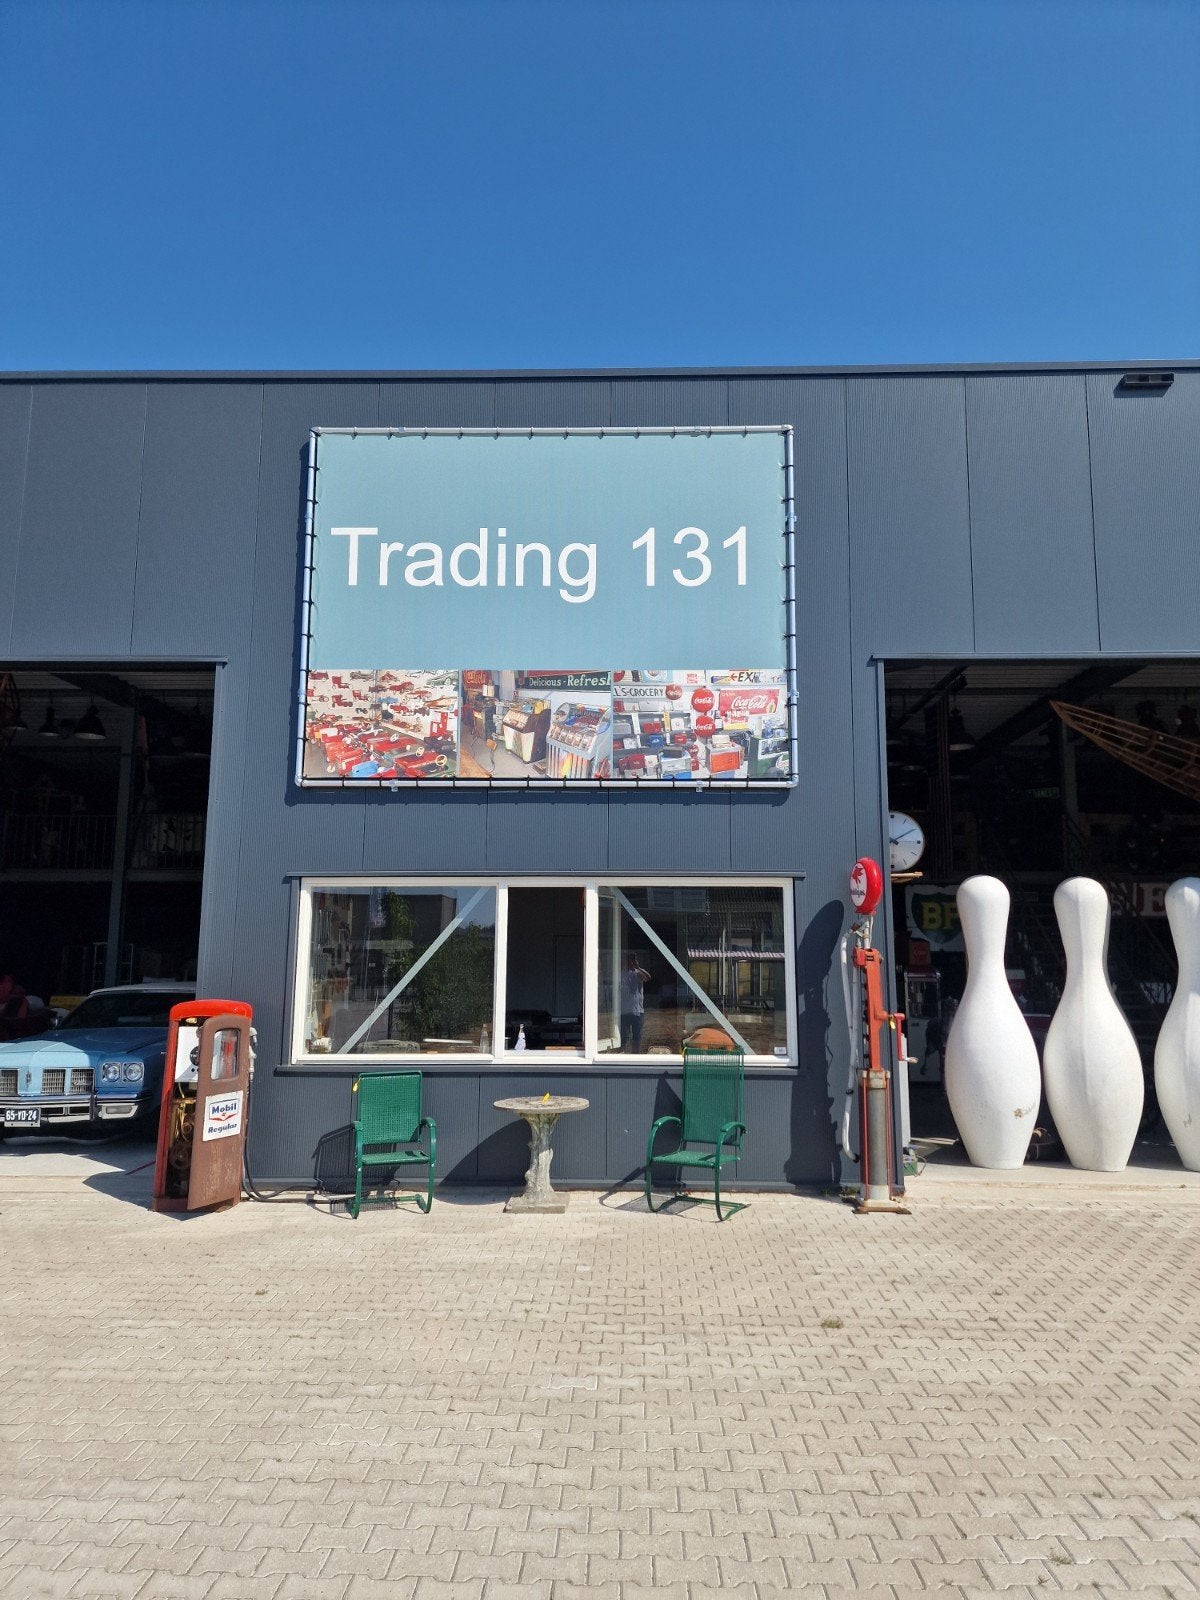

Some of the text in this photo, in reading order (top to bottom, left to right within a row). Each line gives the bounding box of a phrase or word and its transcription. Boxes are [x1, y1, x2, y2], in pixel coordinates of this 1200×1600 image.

[331, 526, 748, 604] Trading 131
[529, 677, 562, 687] Delicious
[613, 686, 664, 697] L'S-GROCERY
[921, 899, 960, 931] BP
[211, 1102, 237, 1115] Mobil
[208, 1123, 238, 1134] Regular
